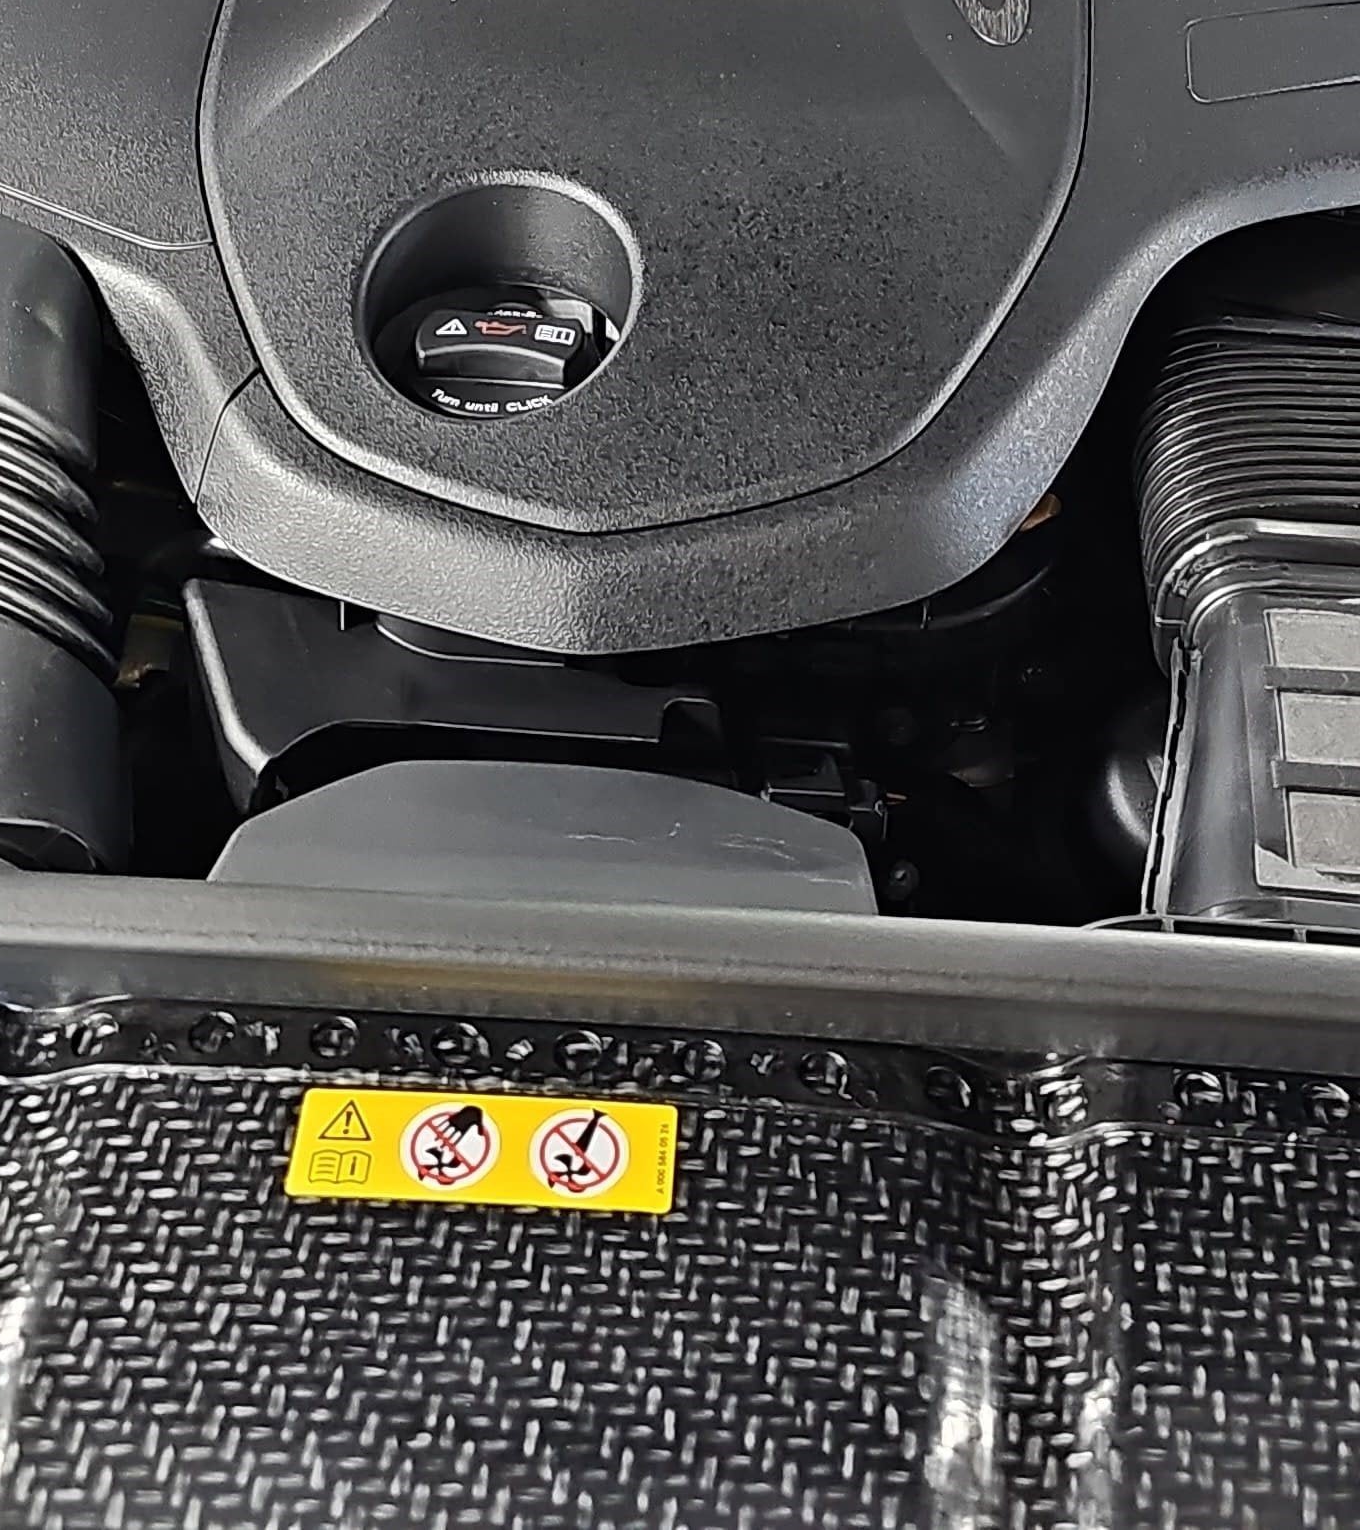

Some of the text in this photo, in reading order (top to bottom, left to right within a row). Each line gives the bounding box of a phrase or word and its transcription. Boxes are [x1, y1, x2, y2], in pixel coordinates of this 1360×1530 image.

[431, 388, 554, 413] Turn until CLICK
